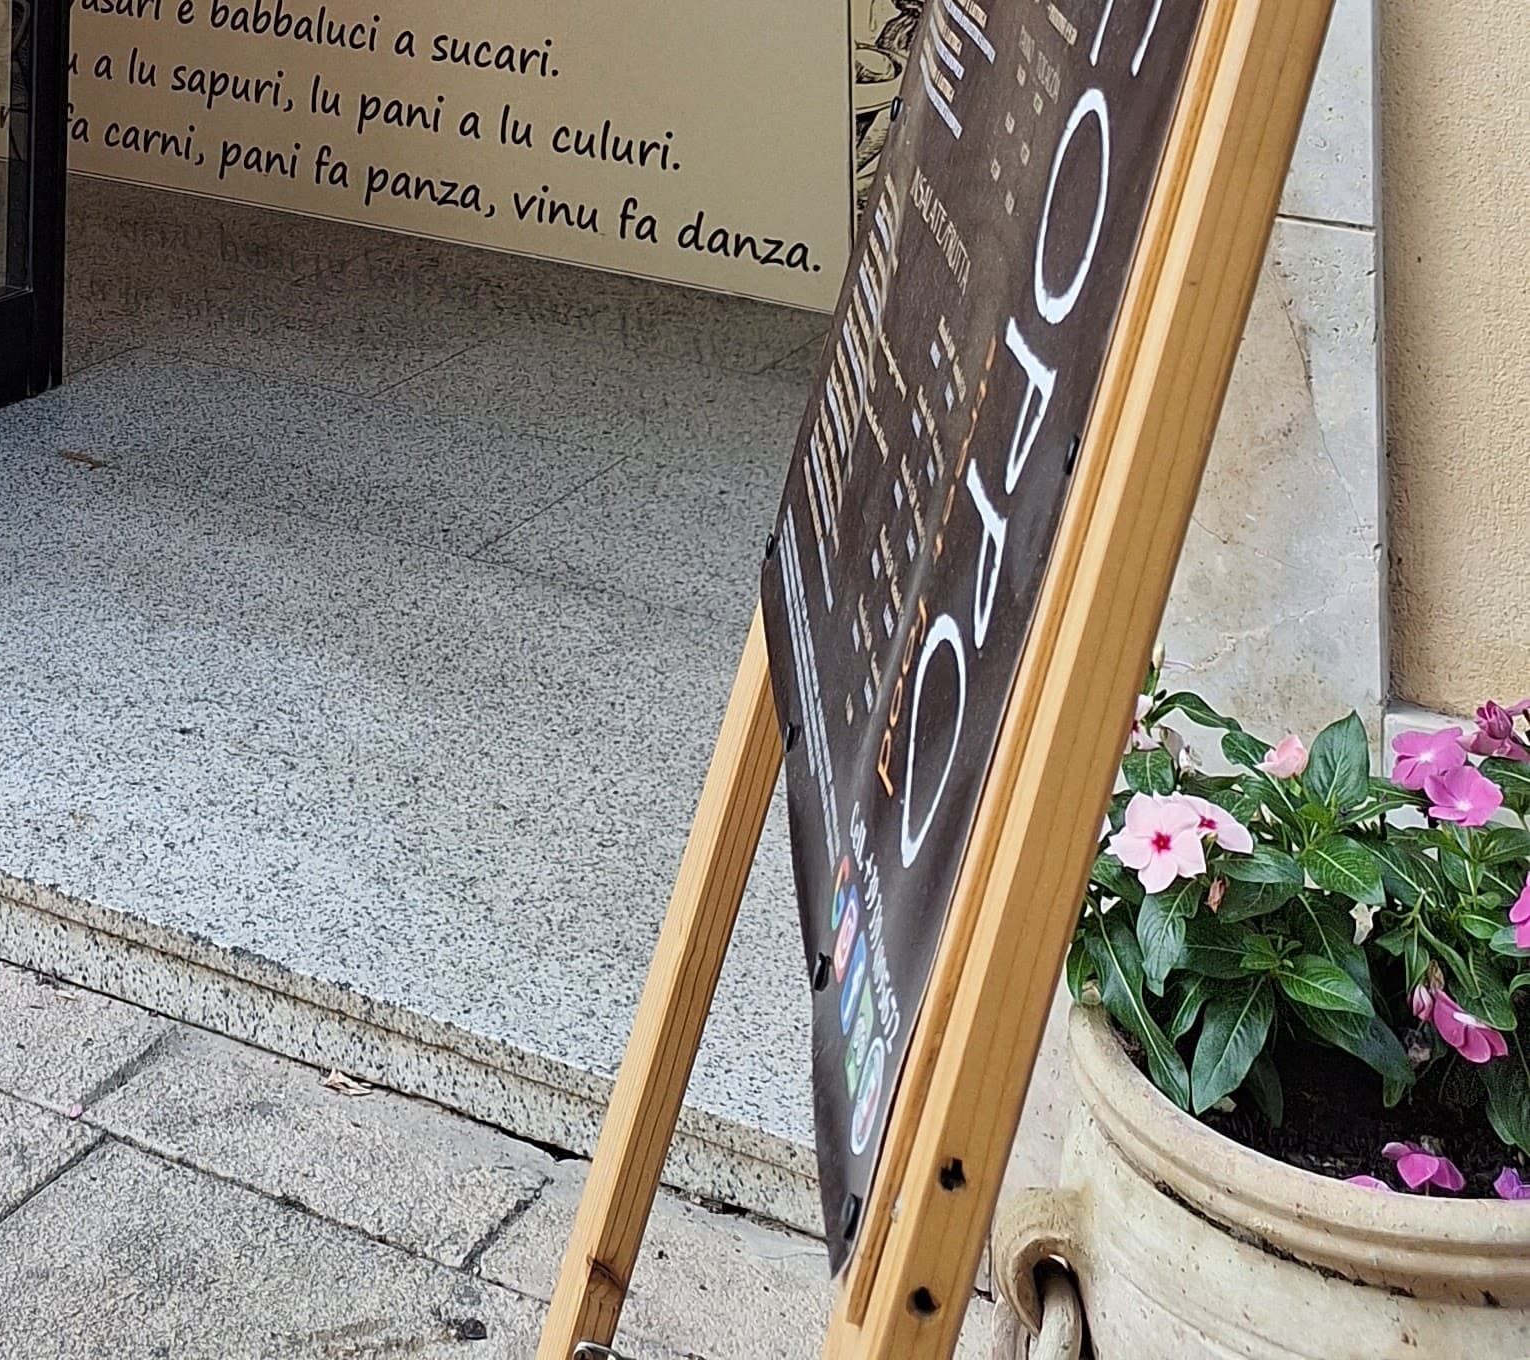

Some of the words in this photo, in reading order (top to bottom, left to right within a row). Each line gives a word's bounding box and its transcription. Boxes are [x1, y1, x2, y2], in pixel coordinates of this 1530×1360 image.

[176, 0, 195, 25] e
[393, 30, 415, 59] a
[431, 32, 560, 79] sucari.
[92, 50, 113, 80] a
[128, 50, 157, 89] lu
[170, 63, 295, 114] sapuri,
[310, 69, 342, 114] lu
[357, 87, 442, 135] pani
[458, 107, 481, 138] a
[499, 105, 534, 150] lu
[551, 116, 682, 172] culuri.
[102, 121, 206, 168] carni,
[218, 135, 299, 180] pani
[313, 145, 350, 189] fa
[365, 157, 497, 218] panza,
[513, 186, 601, 234] vinu
[617, 198, 660, 246] fa
[676, 209, 823, 274] danza.
